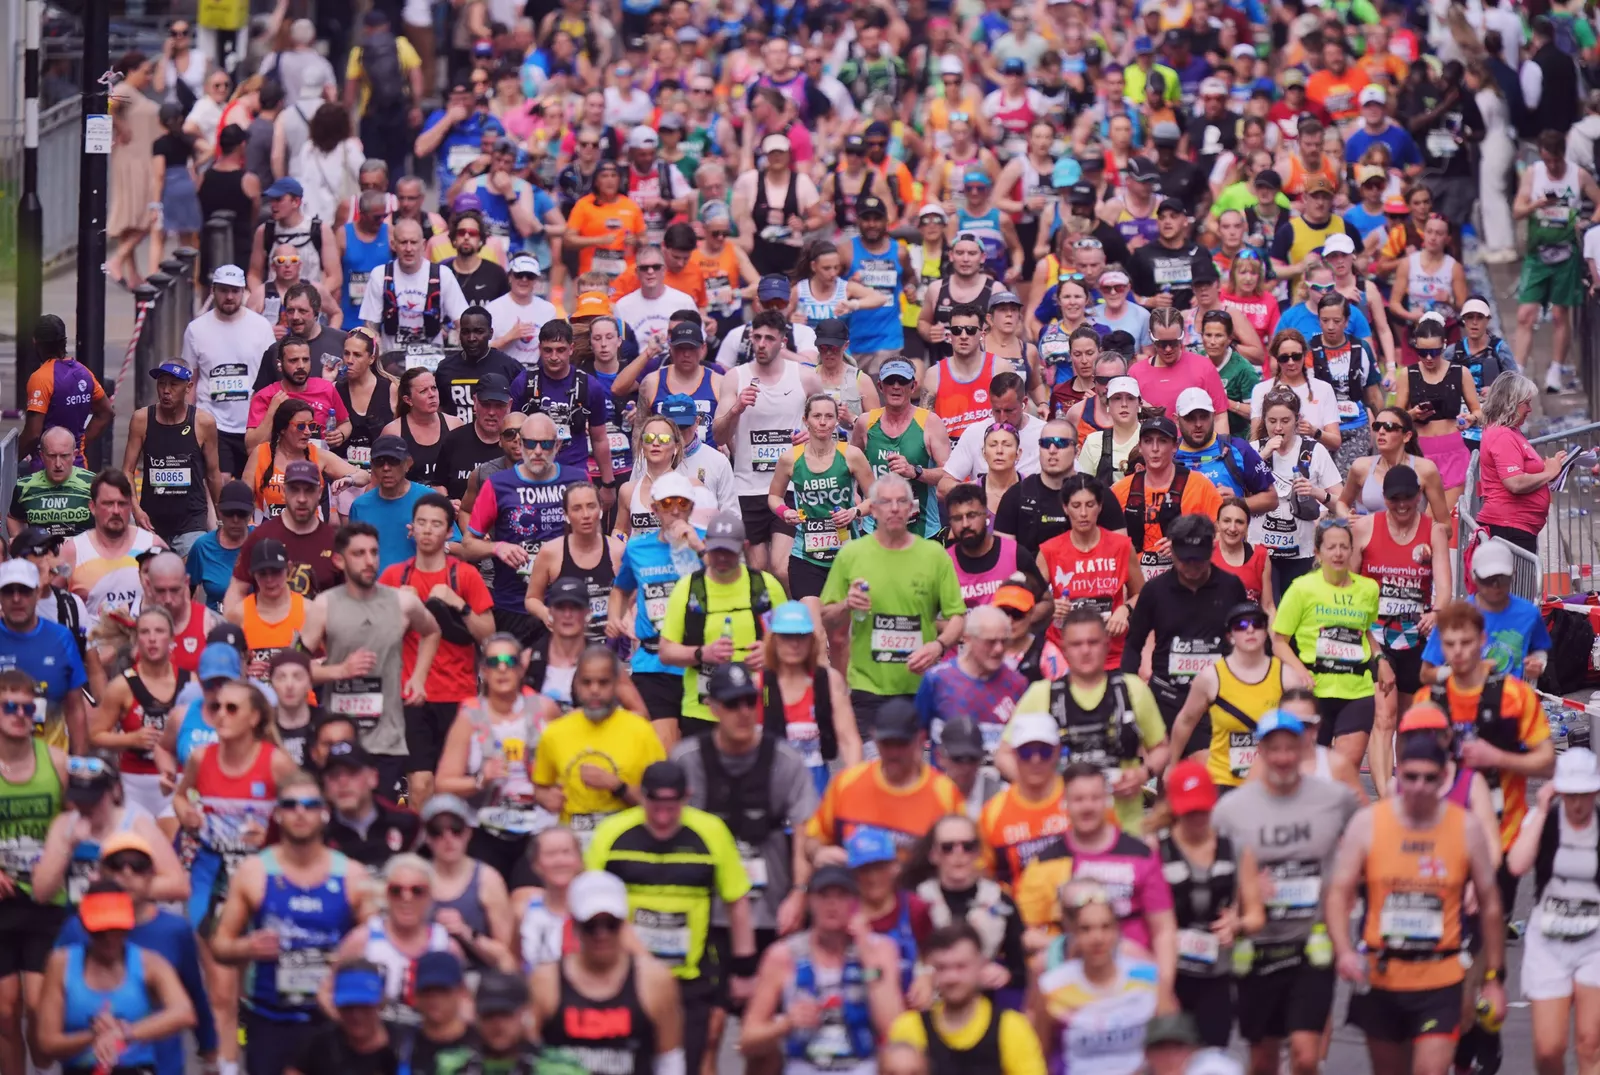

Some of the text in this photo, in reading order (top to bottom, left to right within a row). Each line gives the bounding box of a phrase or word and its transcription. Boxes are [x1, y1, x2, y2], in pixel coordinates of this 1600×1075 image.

[215, 379, 243, 390] T1518
[66, 393, 92, 406] sense
[753, 432, 768, 443] tcs
[150, 456, 165, 467] tcs
[155, 471, 184, 482] 60865
[803, 476, 838, 491] ABBIE
[796, 486, 851, 506] NSPCC
[41, 497, 69, 509] TONY
[541, 507, 564, 515] CANC
[632, 514, 649, 526] tcs
[807, 520, 823, 531] tcs
[1264, 533, 1294, 546] 63734
[1141, 552, 1157, 564] tcs
[1075, 557, 1117, 574] KATIE
[1367, 564, 1417, 577] Leukaemia
[643, 582, 665, 598] tcs
[1072, 577, 1118, 592] myton
[106, 590, 136, 602] DAN
[1334, 593, 1355, 606] LIZ
[1315, 604, 1368, 623] Headway
[1386, 602, 1418, 613] 57877
[875, 615, 895, 629] tcs
[880, 634, 916, 649] 36277
[1259, 821, 1312, 848] LDN
